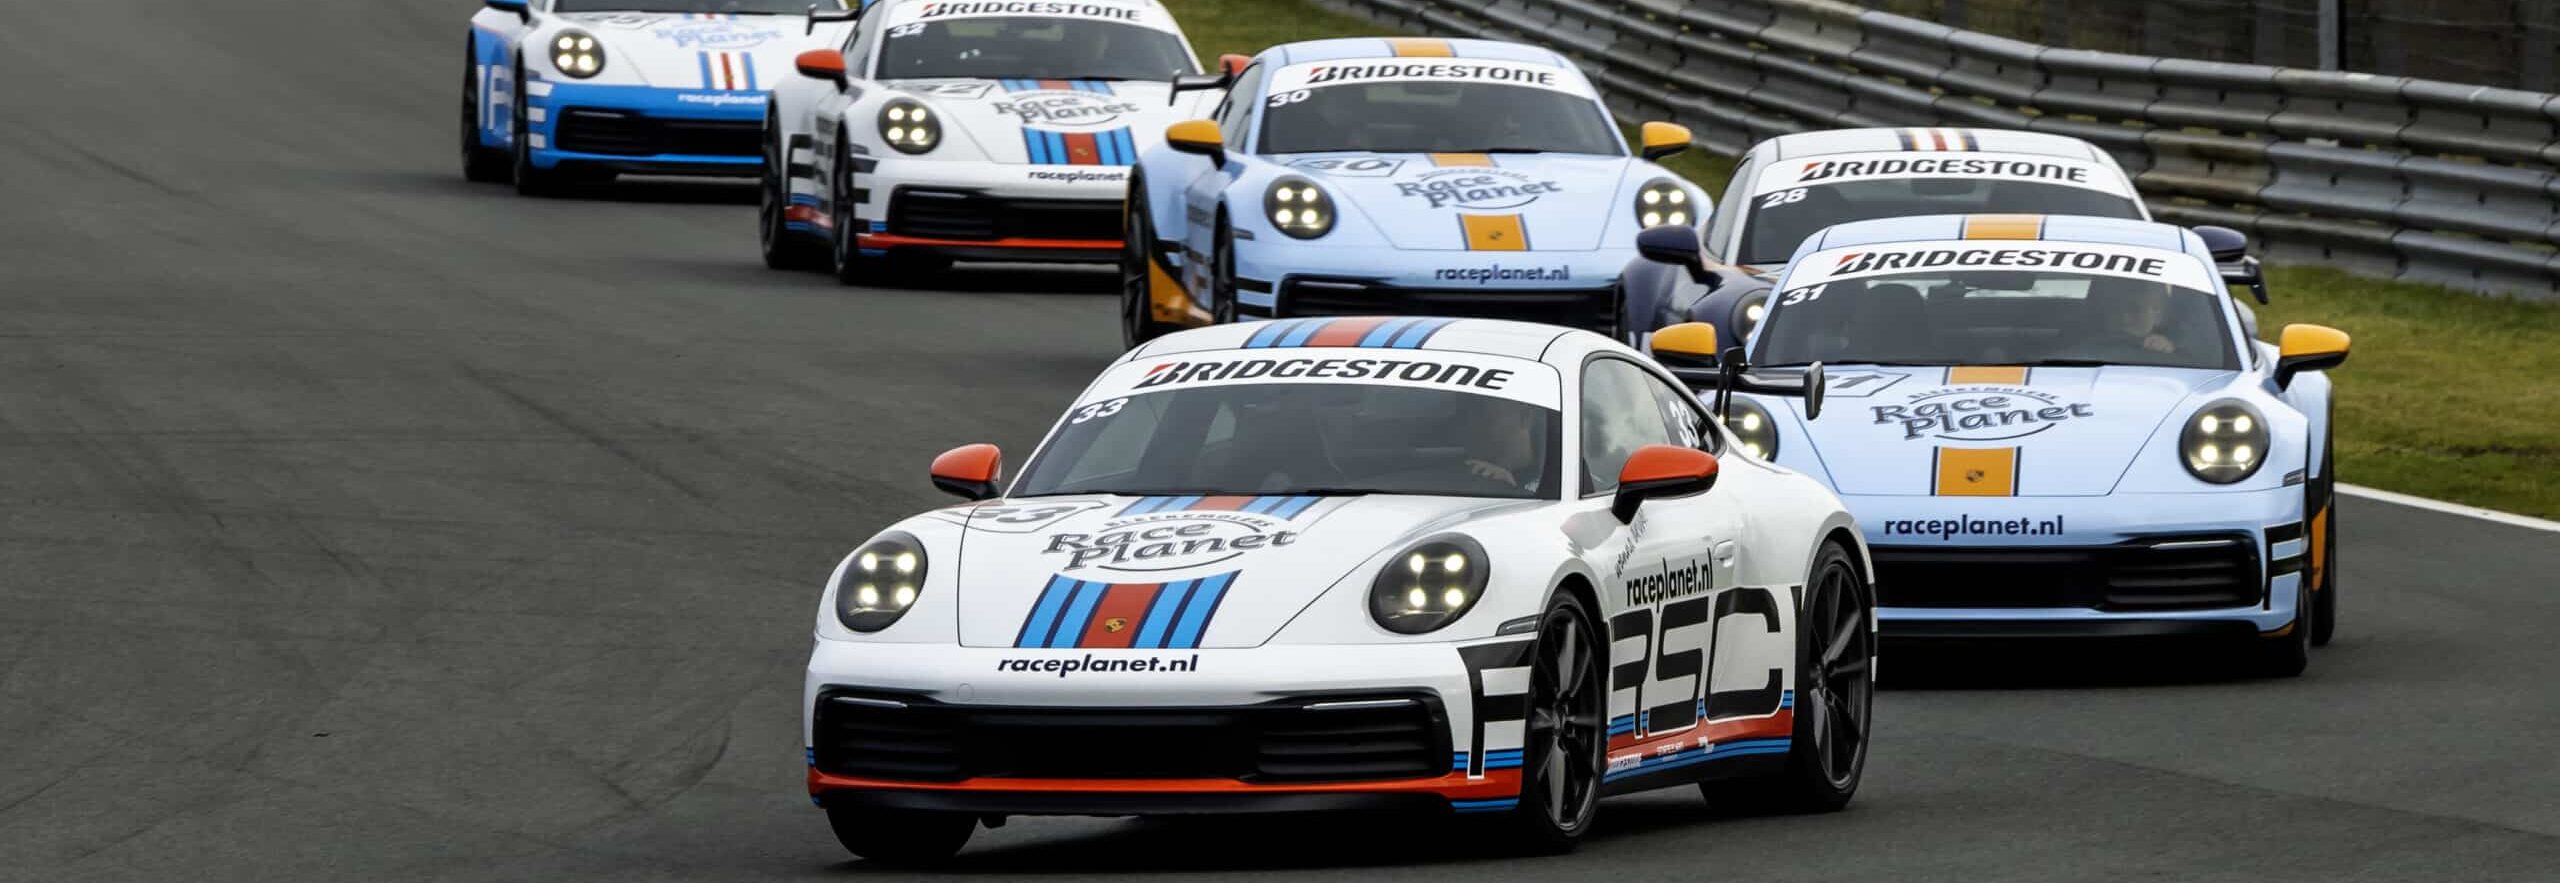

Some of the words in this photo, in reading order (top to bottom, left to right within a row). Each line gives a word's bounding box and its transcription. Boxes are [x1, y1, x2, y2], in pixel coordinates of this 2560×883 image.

[920, 1, 1142, 21] BRIDGESTONE
[890, 23, 928, 38] 32
[1306, 64, 1557, 86] BRIDGESTONE
[677, 93, 767, 106] raceplanet
[992, 97, 1081, 114] Race
[1268, 89, 1311, 108] 30
[1017, 101, 1141, 124] Planet
[1028, 170, 1131, 183] raceplanet.
[1798, 158, 2088, 183] BRIDGESTONE
[1394, 174, 1497, 196] Race
[1423, 180, 1563, 209] Planet
[1760, 187, 1807, 209] 28
[1435, 264, 1570, 285] raceplanet.nl
[1829, 249, 2167, 277] BRIDGESTONE
[1782, 283, 1827, 307] 31
[1131, 358, 1515, 391] BRIDGESTONE
[1072, 397, 1129, 424] 33
[1870, 395, 2011, 425] Race
[1903, 401, 2094, 441] Planet
[1669, 400, 1701, 449] 33
[1041, 521, 1216, 555] Race
[1884, 513, 2064, 541] raceplanet.nl
[1063, 529, 1299, 572] Planet
[1626, 546, 1714, 614] raceplanet.nl
[997, 653, 1199, 679] raceplanet.nl
